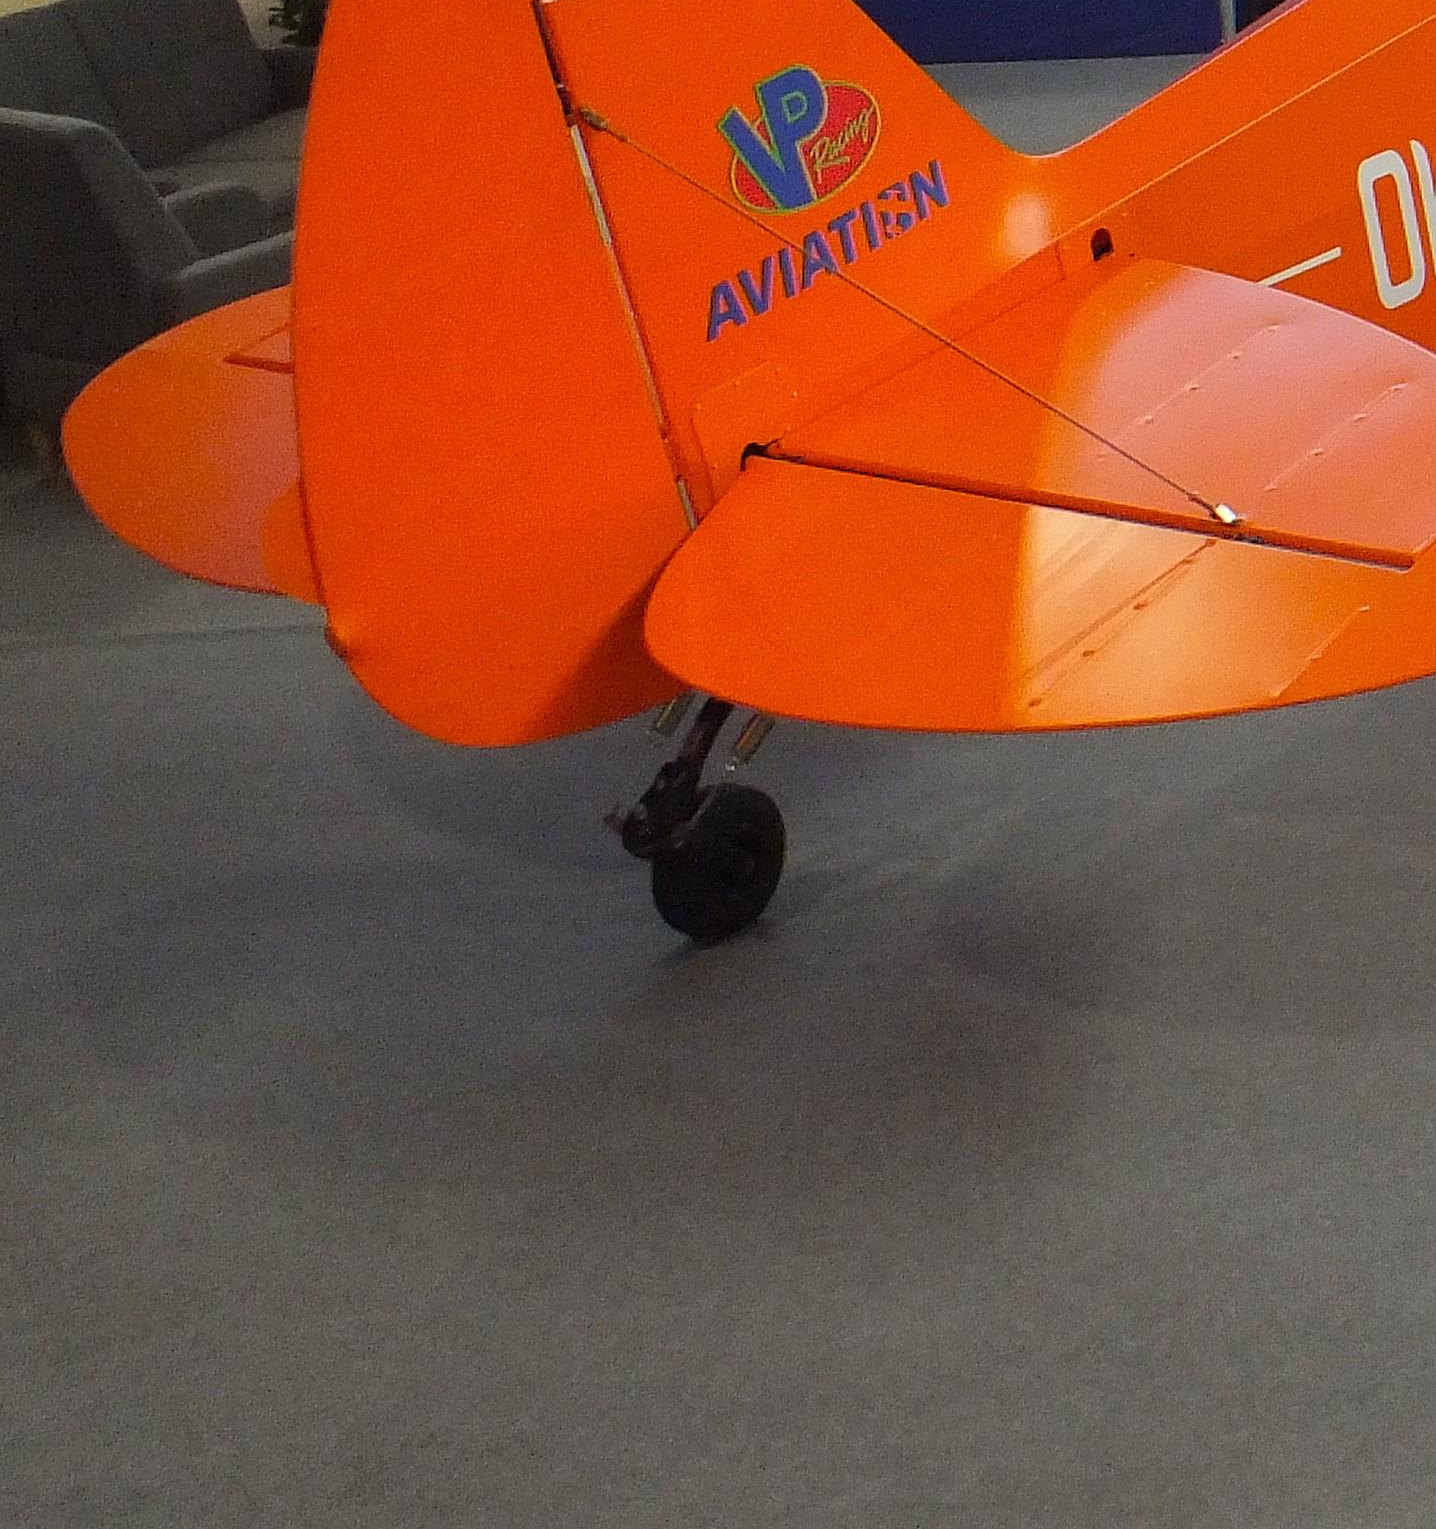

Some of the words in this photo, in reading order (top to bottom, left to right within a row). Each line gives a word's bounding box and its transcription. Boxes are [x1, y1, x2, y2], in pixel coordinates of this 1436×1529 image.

[717, 63, 828, 211] VP
[809, 102, 877, 184] Racing
[707, 158, 950, 342] AVIATION
